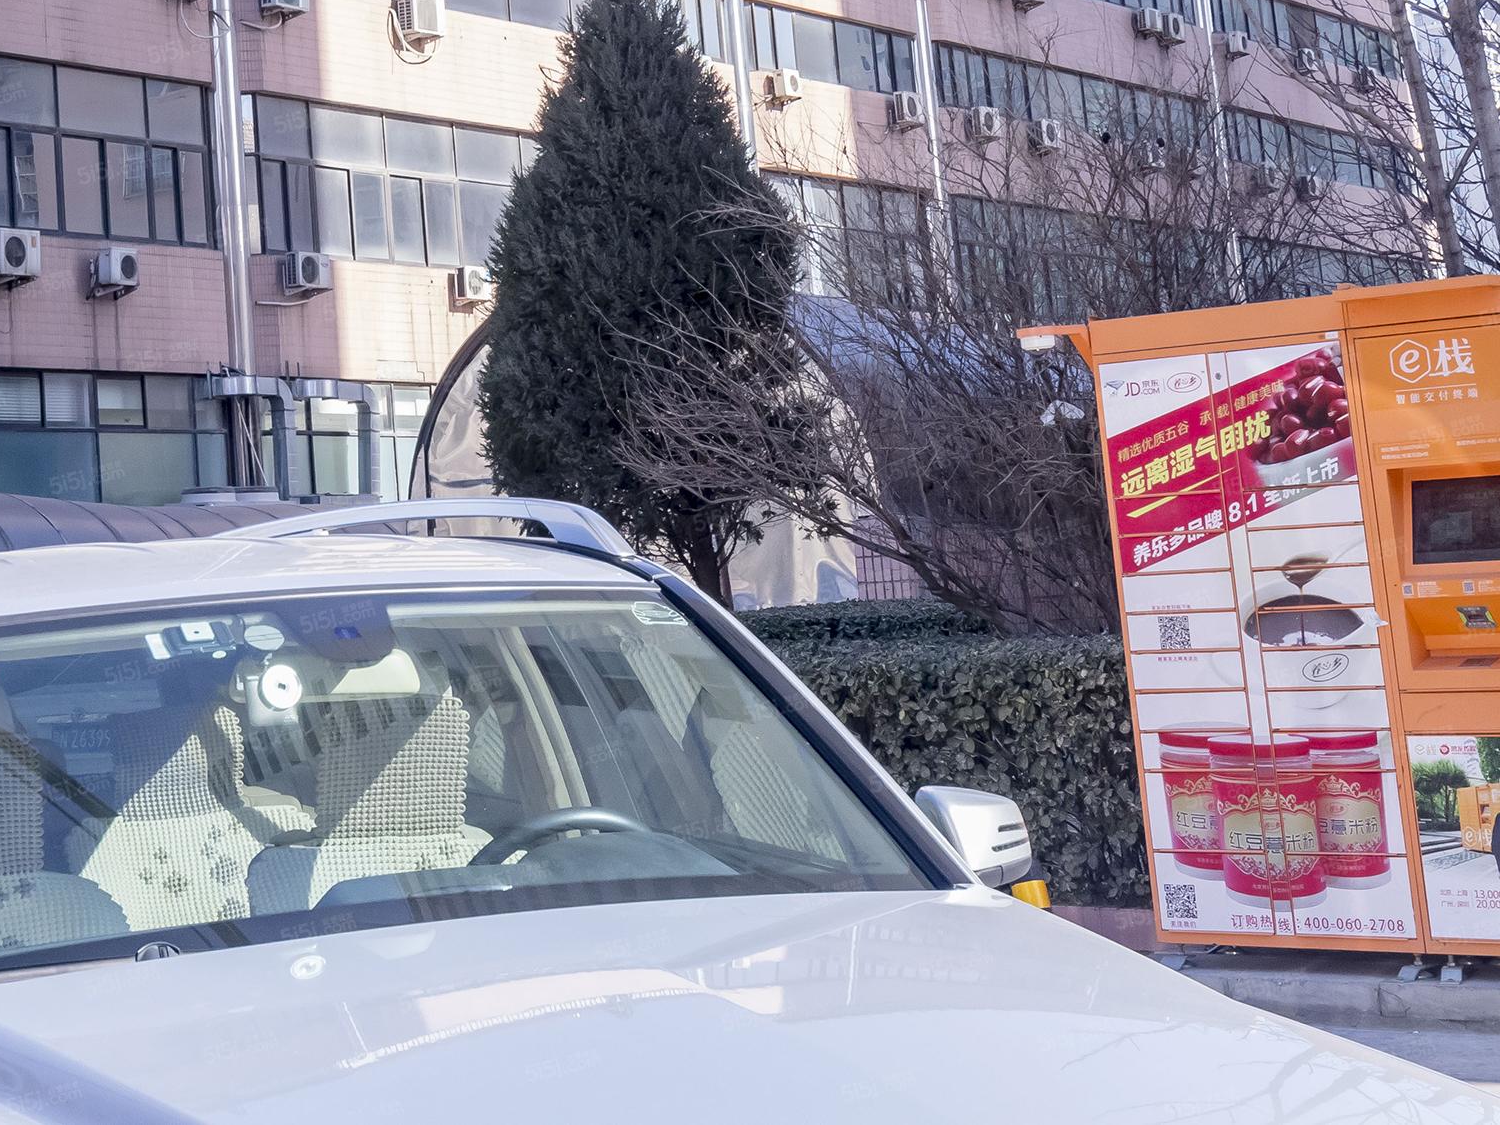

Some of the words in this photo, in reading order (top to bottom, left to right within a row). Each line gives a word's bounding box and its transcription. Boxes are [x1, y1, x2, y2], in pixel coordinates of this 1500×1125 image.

[1396, 388, 1478, 404] 智能交付终端
[1117, 421, 1189, 463] 精选优质五谷
[1120, 411, 1271, 497] 远离湿气困扰
